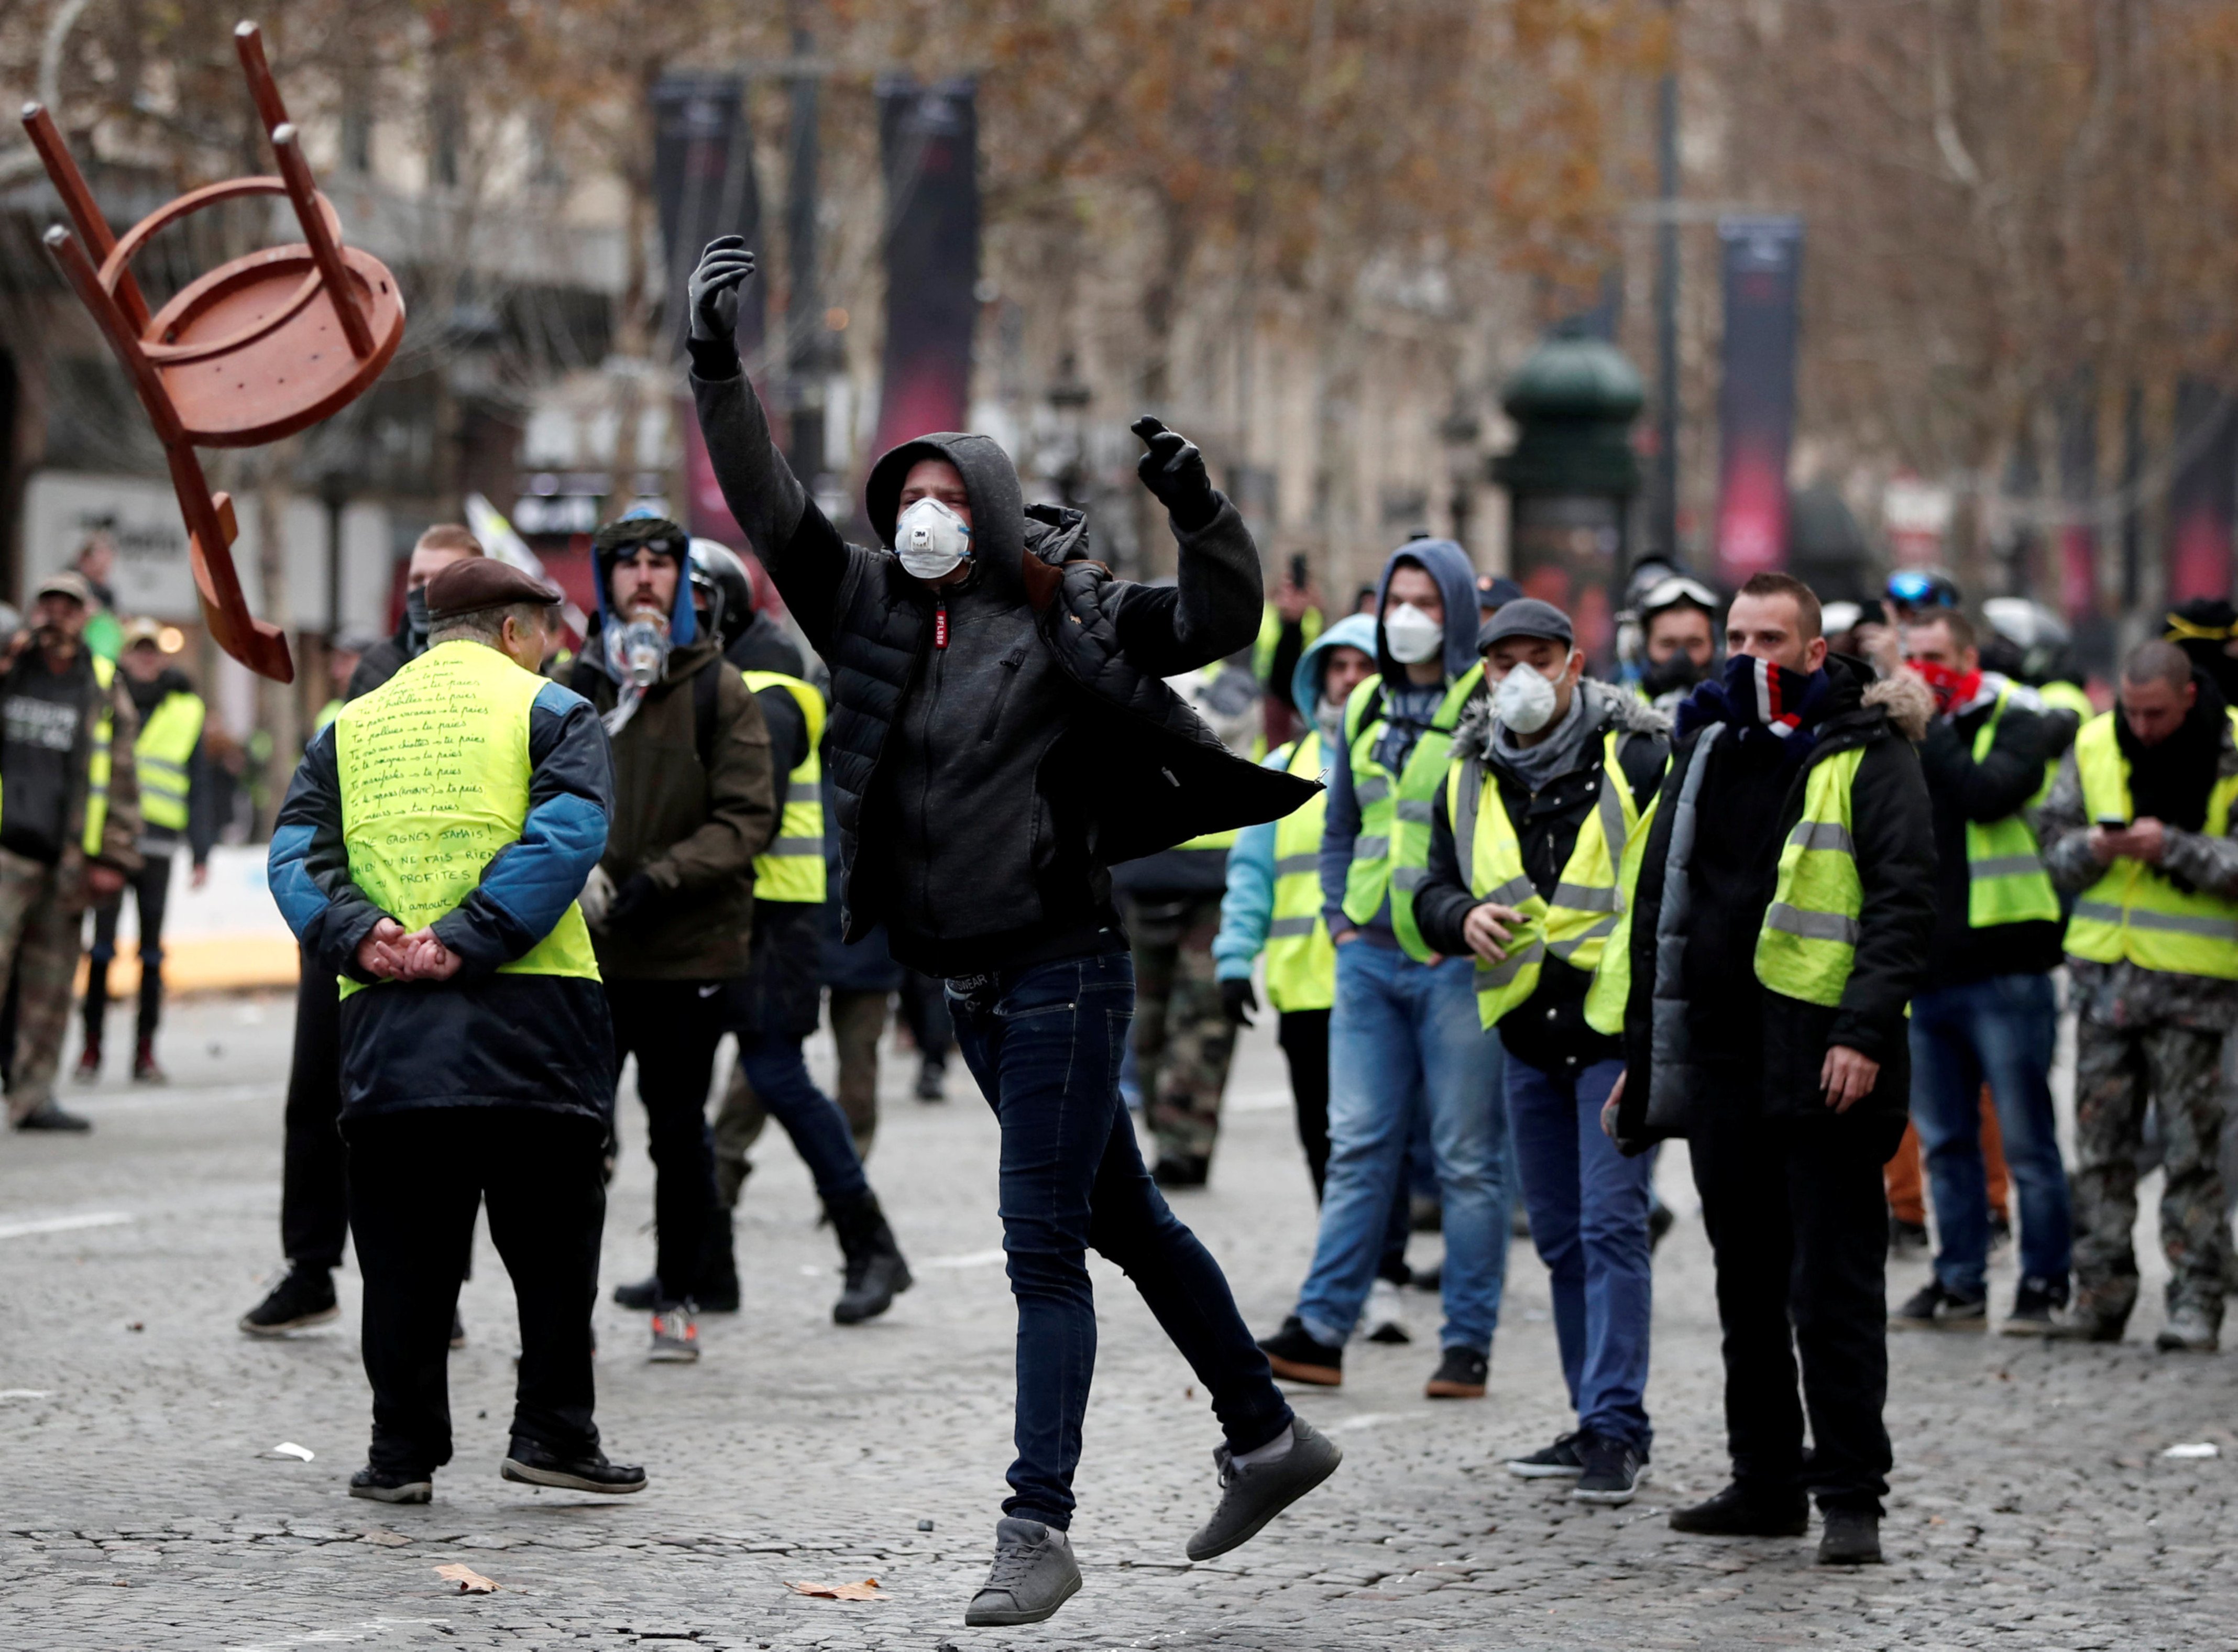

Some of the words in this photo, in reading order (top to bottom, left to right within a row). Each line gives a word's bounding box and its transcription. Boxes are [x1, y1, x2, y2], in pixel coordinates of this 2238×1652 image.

[446, 680, 480, 690] paies
[435, 693, 446, 701] tu
[449, 692, 476, 705] paies
[449, 703, 458, 714] tu
[460, 705, 489, 718] paies
[352, 734, 363, 744] Tu
[422, 720, 434, 731] tu
[438, 718, 467, 735] paies
[349, 749, 360, 760] Tu
[444, 735, 454, 744] tu
[458, 733, 485, 747] paies
[423, 750, 433, 759] tu
[436, 749, 463, 765] paies
[423, 766, 432, 776] tu
[436, 763, 462, 780] paies
[447, 782, 458, 794] tu
[458, 781, 483, 799] paies
[411, 801, 424, 812] tu
[430, 801, 459, 817] paies
[386, 832, 431, 845] GAGNES
[401, 856, 417, 864] NE
